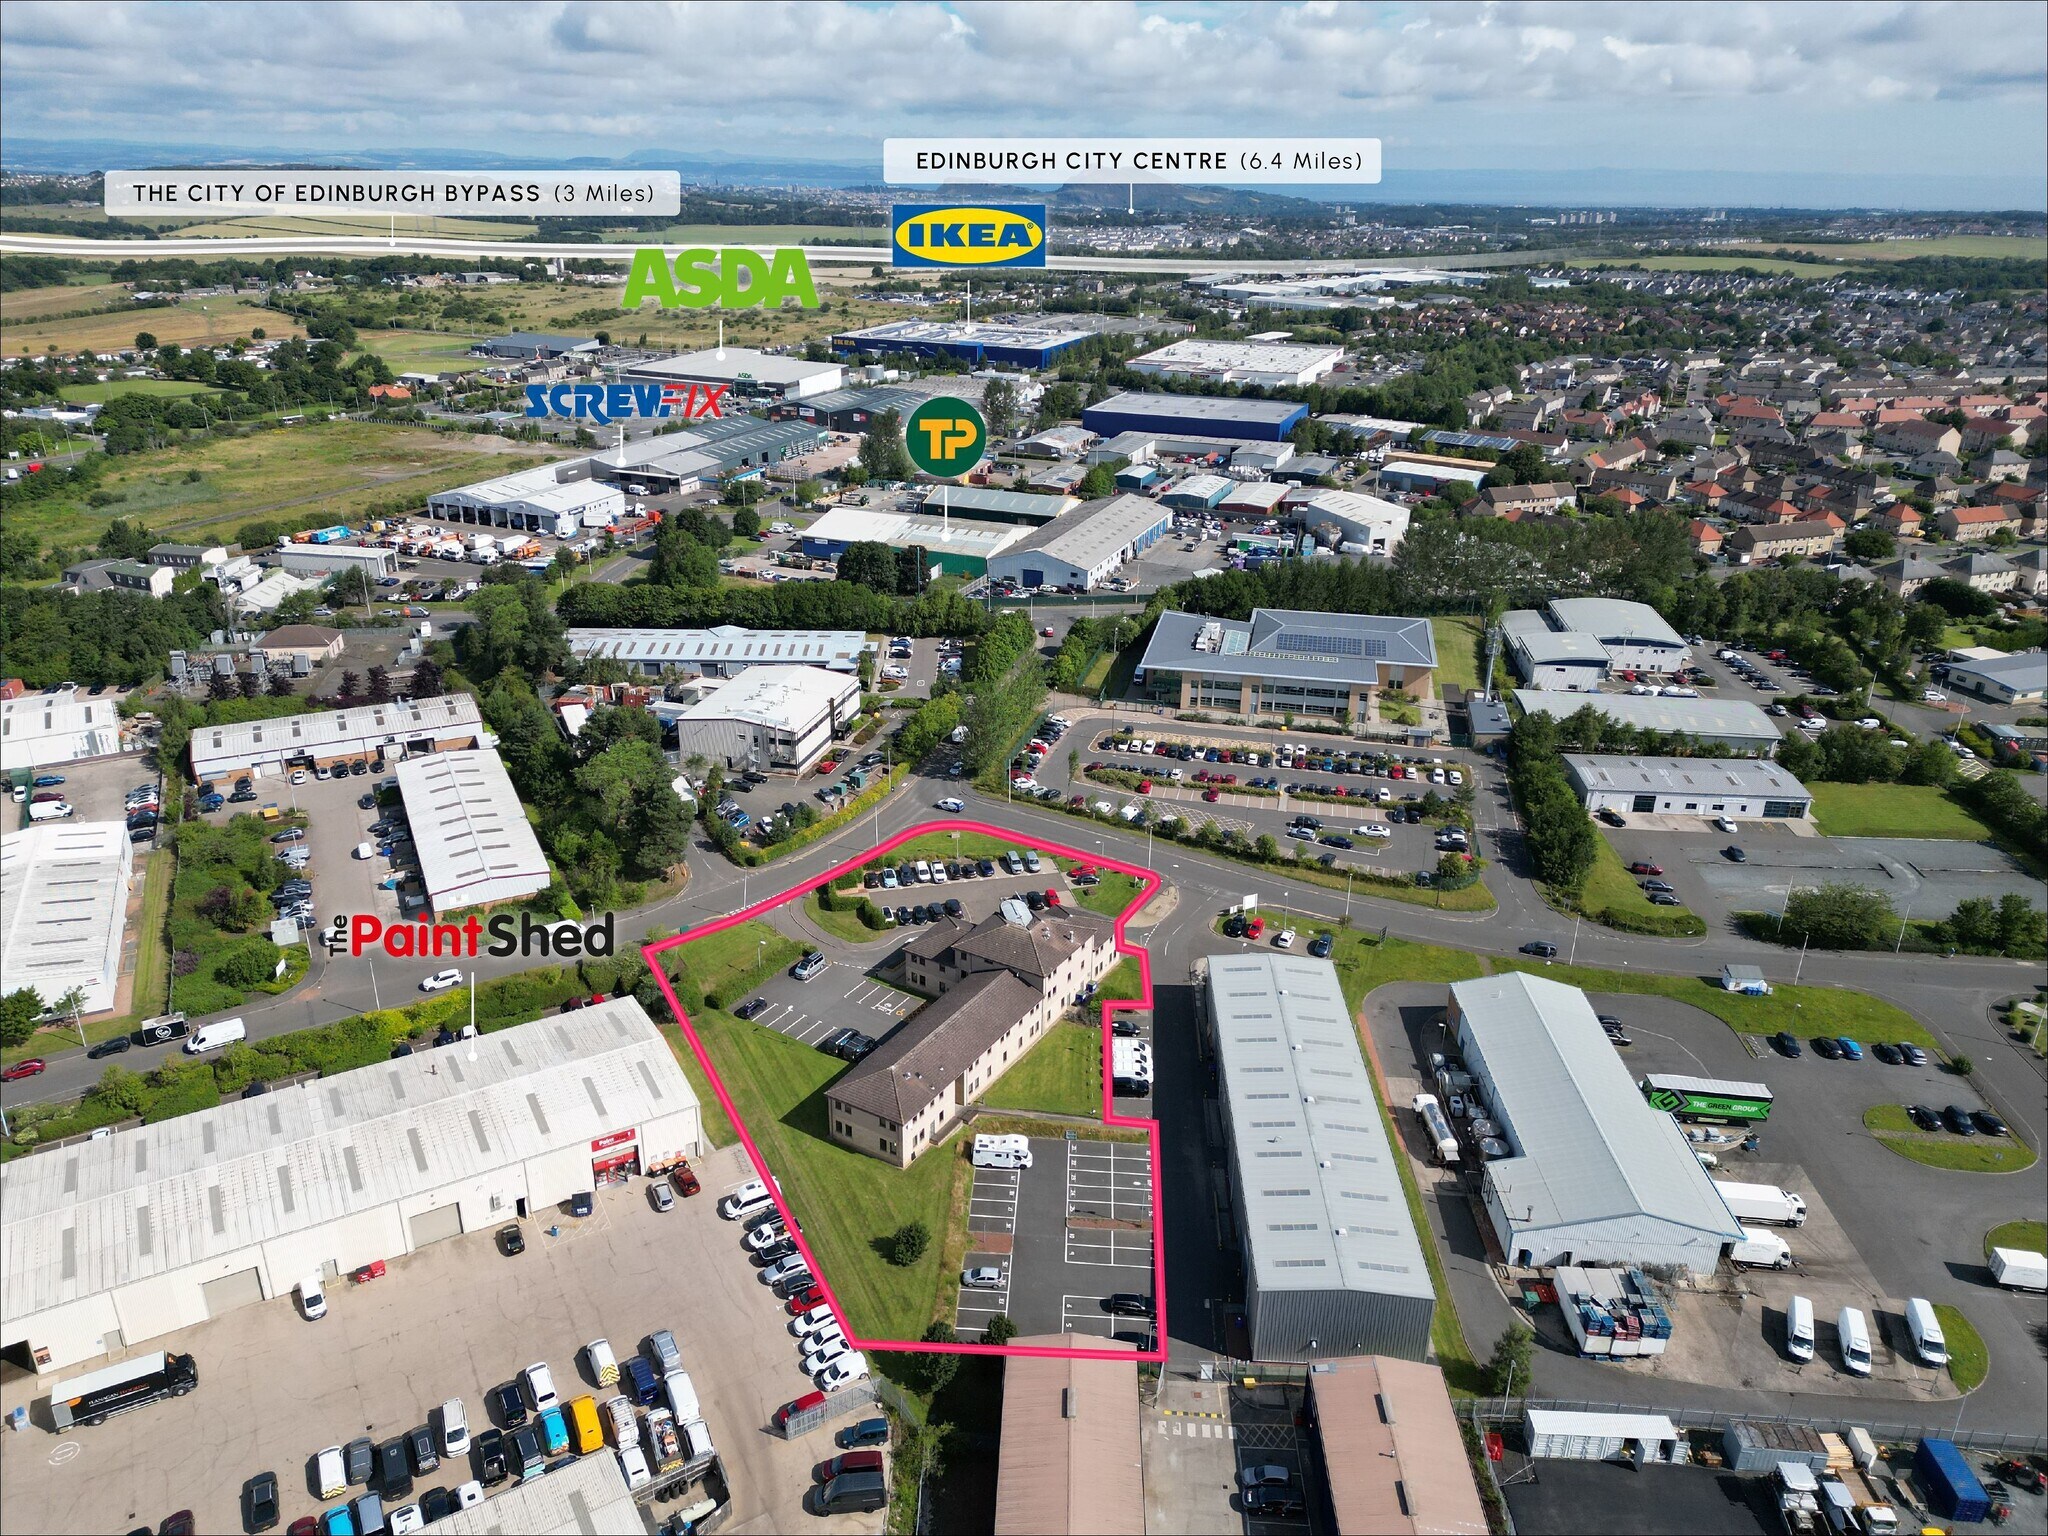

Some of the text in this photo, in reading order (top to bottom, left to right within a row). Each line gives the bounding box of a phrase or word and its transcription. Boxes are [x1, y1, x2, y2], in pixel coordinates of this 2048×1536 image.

[1692, 1100, 1707, 1108] THE
[1707, 1102, 1732, 1110] GREEN
[1732, 1103, 1758, 1112] GROUP
